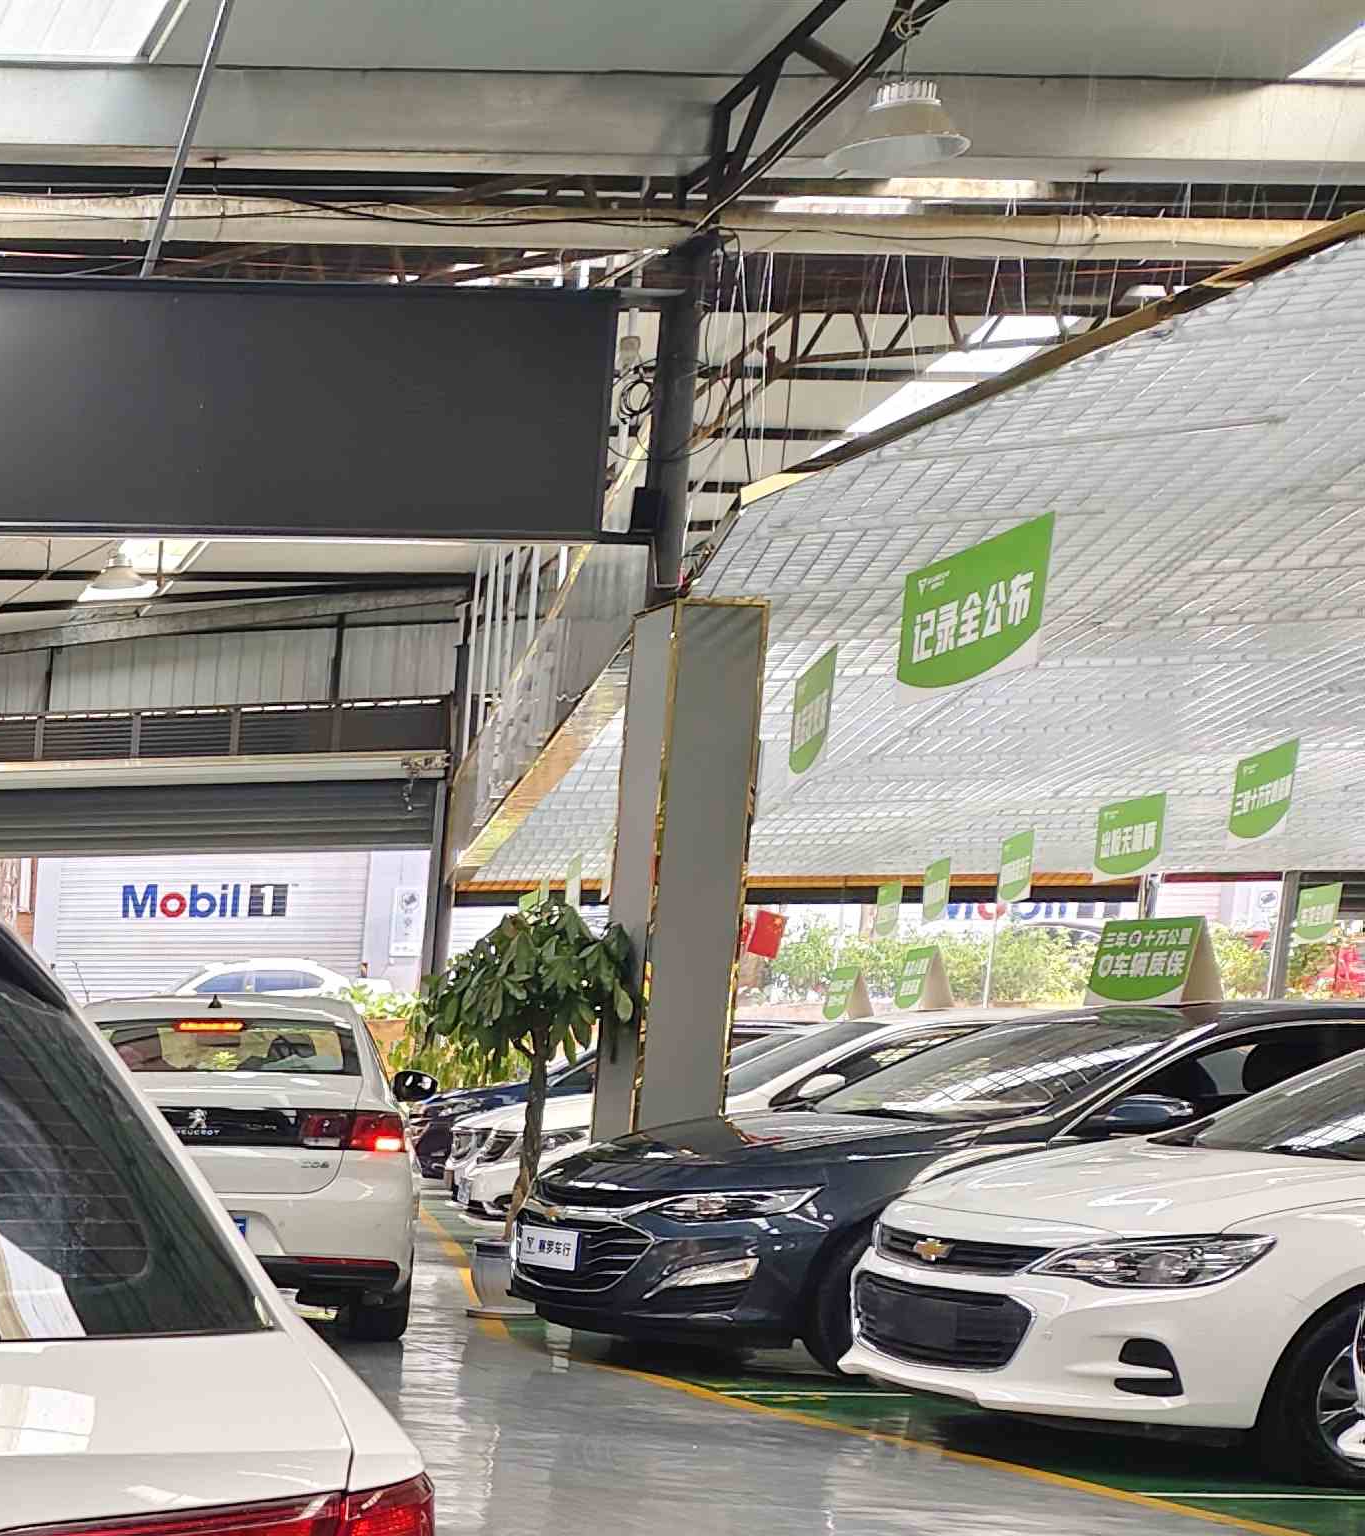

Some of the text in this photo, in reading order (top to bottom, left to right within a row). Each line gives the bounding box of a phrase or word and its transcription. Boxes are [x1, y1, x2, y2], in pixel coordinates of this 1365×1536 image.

[912, 571, 1035, 664] 记录全公布
[122, 883, 241, 919] Mobil
[1111, 950, 1187, 978] 车辆质保
